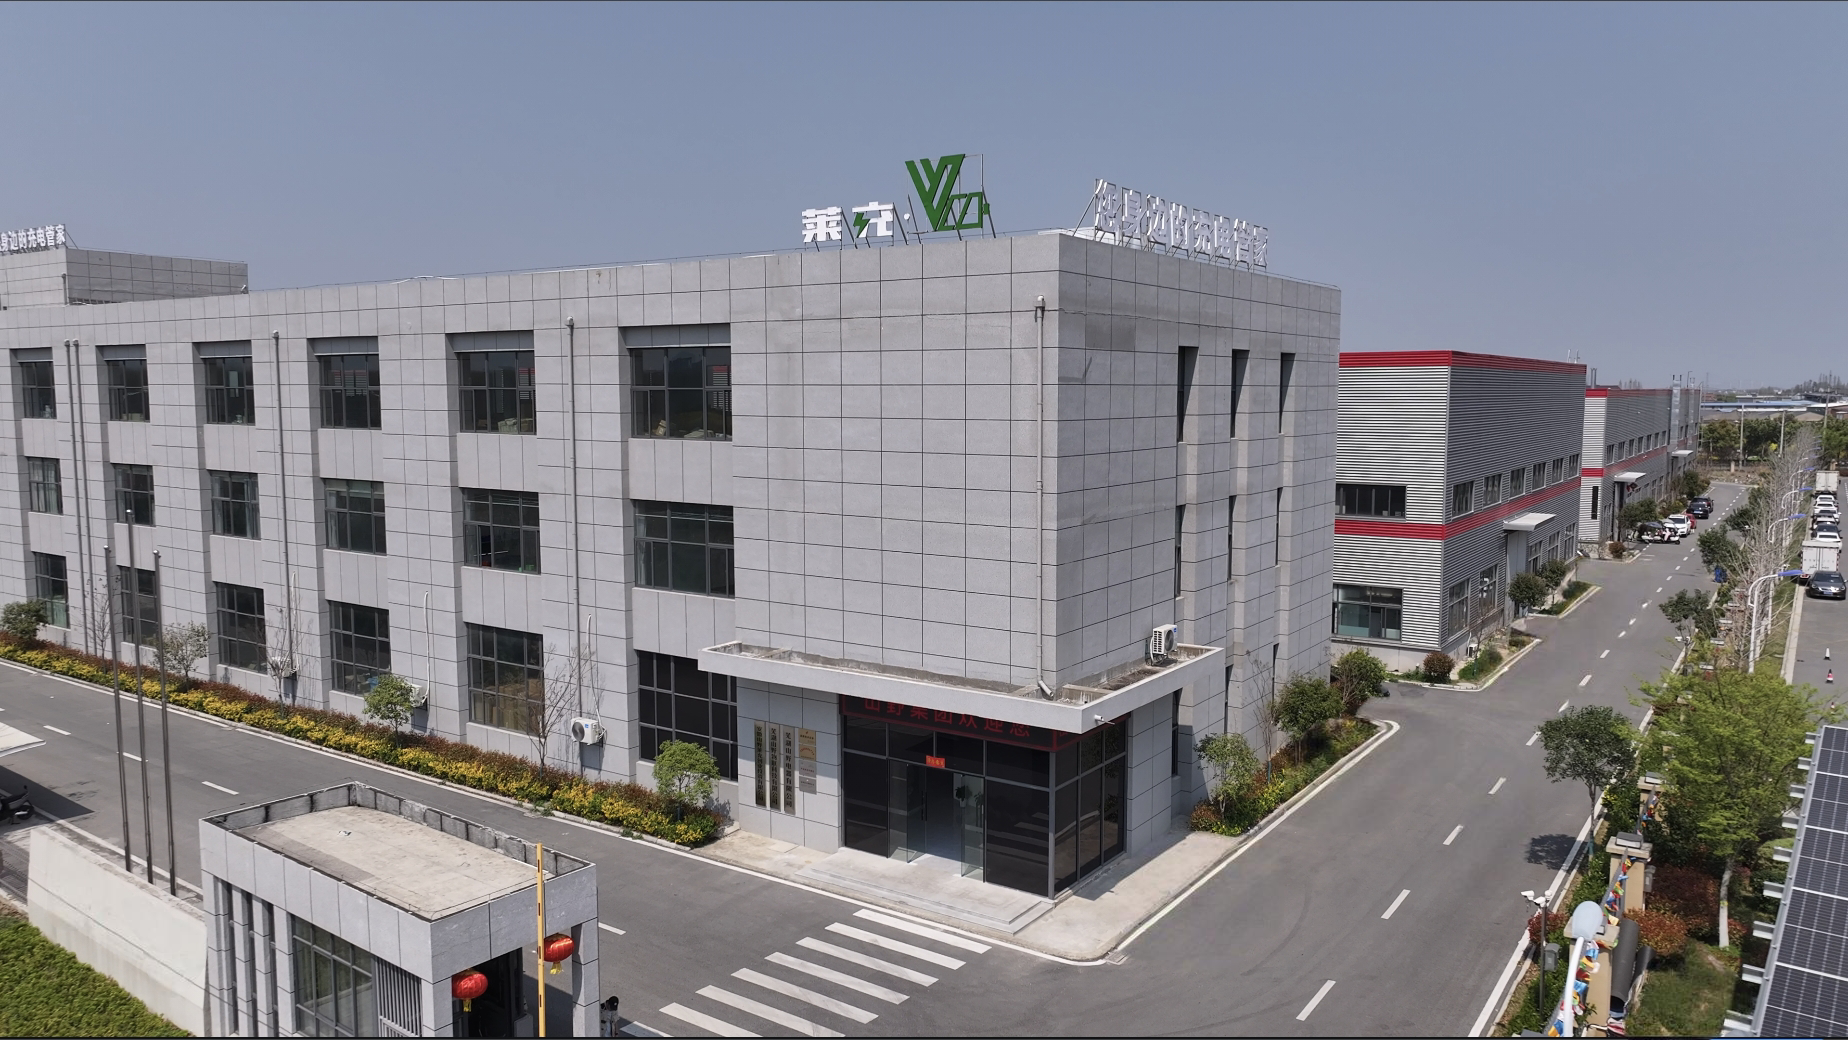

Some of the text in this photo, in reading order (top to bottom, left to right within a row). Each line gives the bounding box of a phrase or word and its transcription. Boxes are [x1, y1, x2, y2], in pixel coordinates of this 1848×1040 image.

[0, 224, 66, 252] 身边的充电管家
